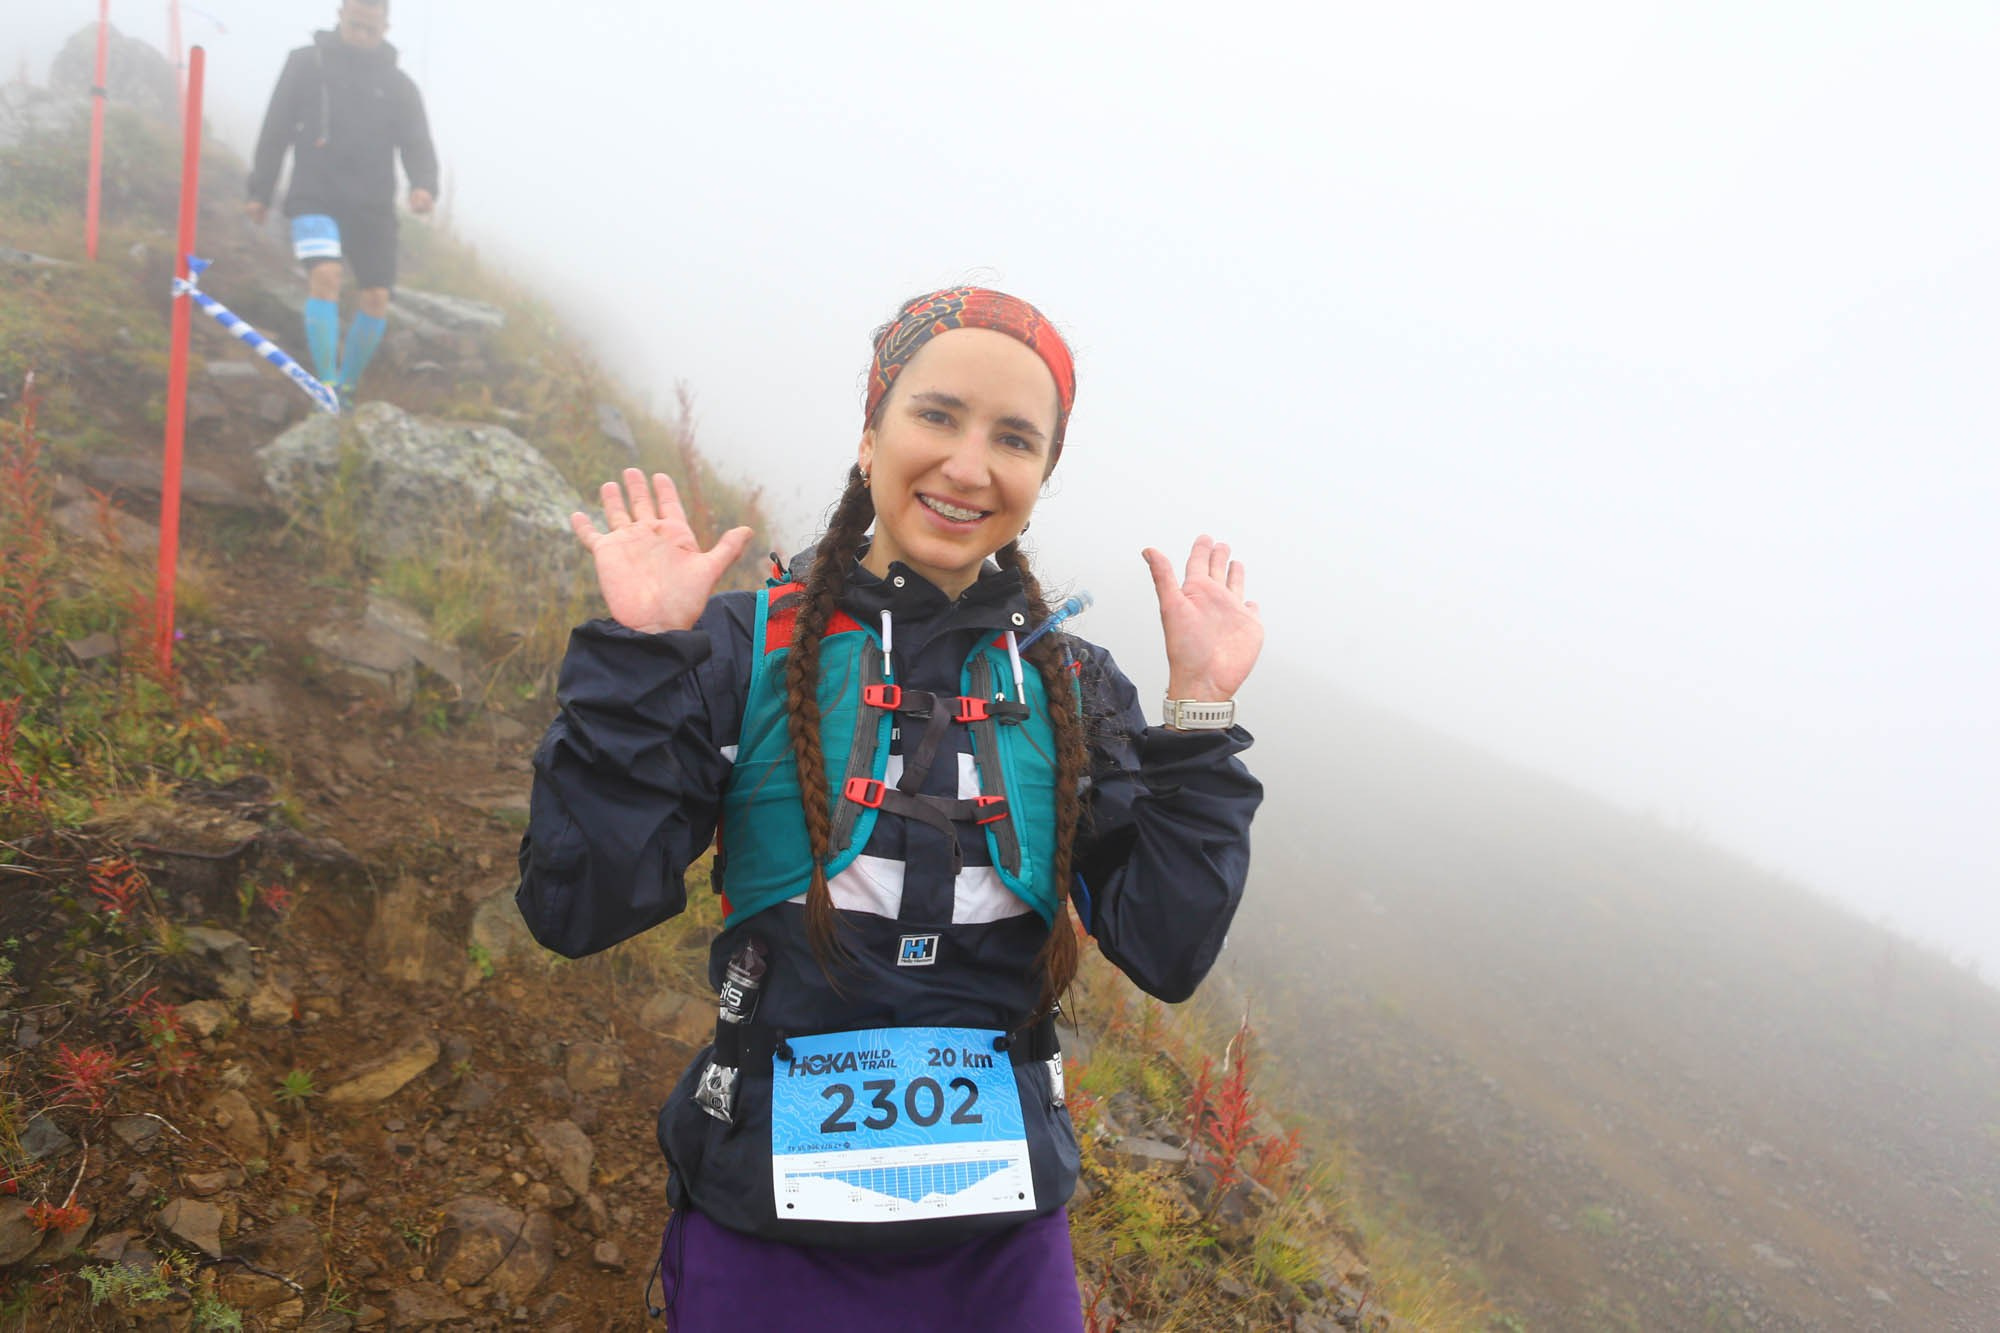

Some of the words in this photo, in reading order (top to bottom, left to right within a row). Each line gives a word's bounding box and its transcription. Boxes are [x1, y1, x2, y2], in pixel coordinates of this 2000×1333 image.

[788, 1051, 858, 1077] HOKA
[857, 1049, 891, 1060] WILD
[860, 1059, 897, 1070] TRAIL
[927, 1047, 957, 1067] 20
[962, 1048, 994, 1069] km
[820, 1076, 983, 1134] 2302
